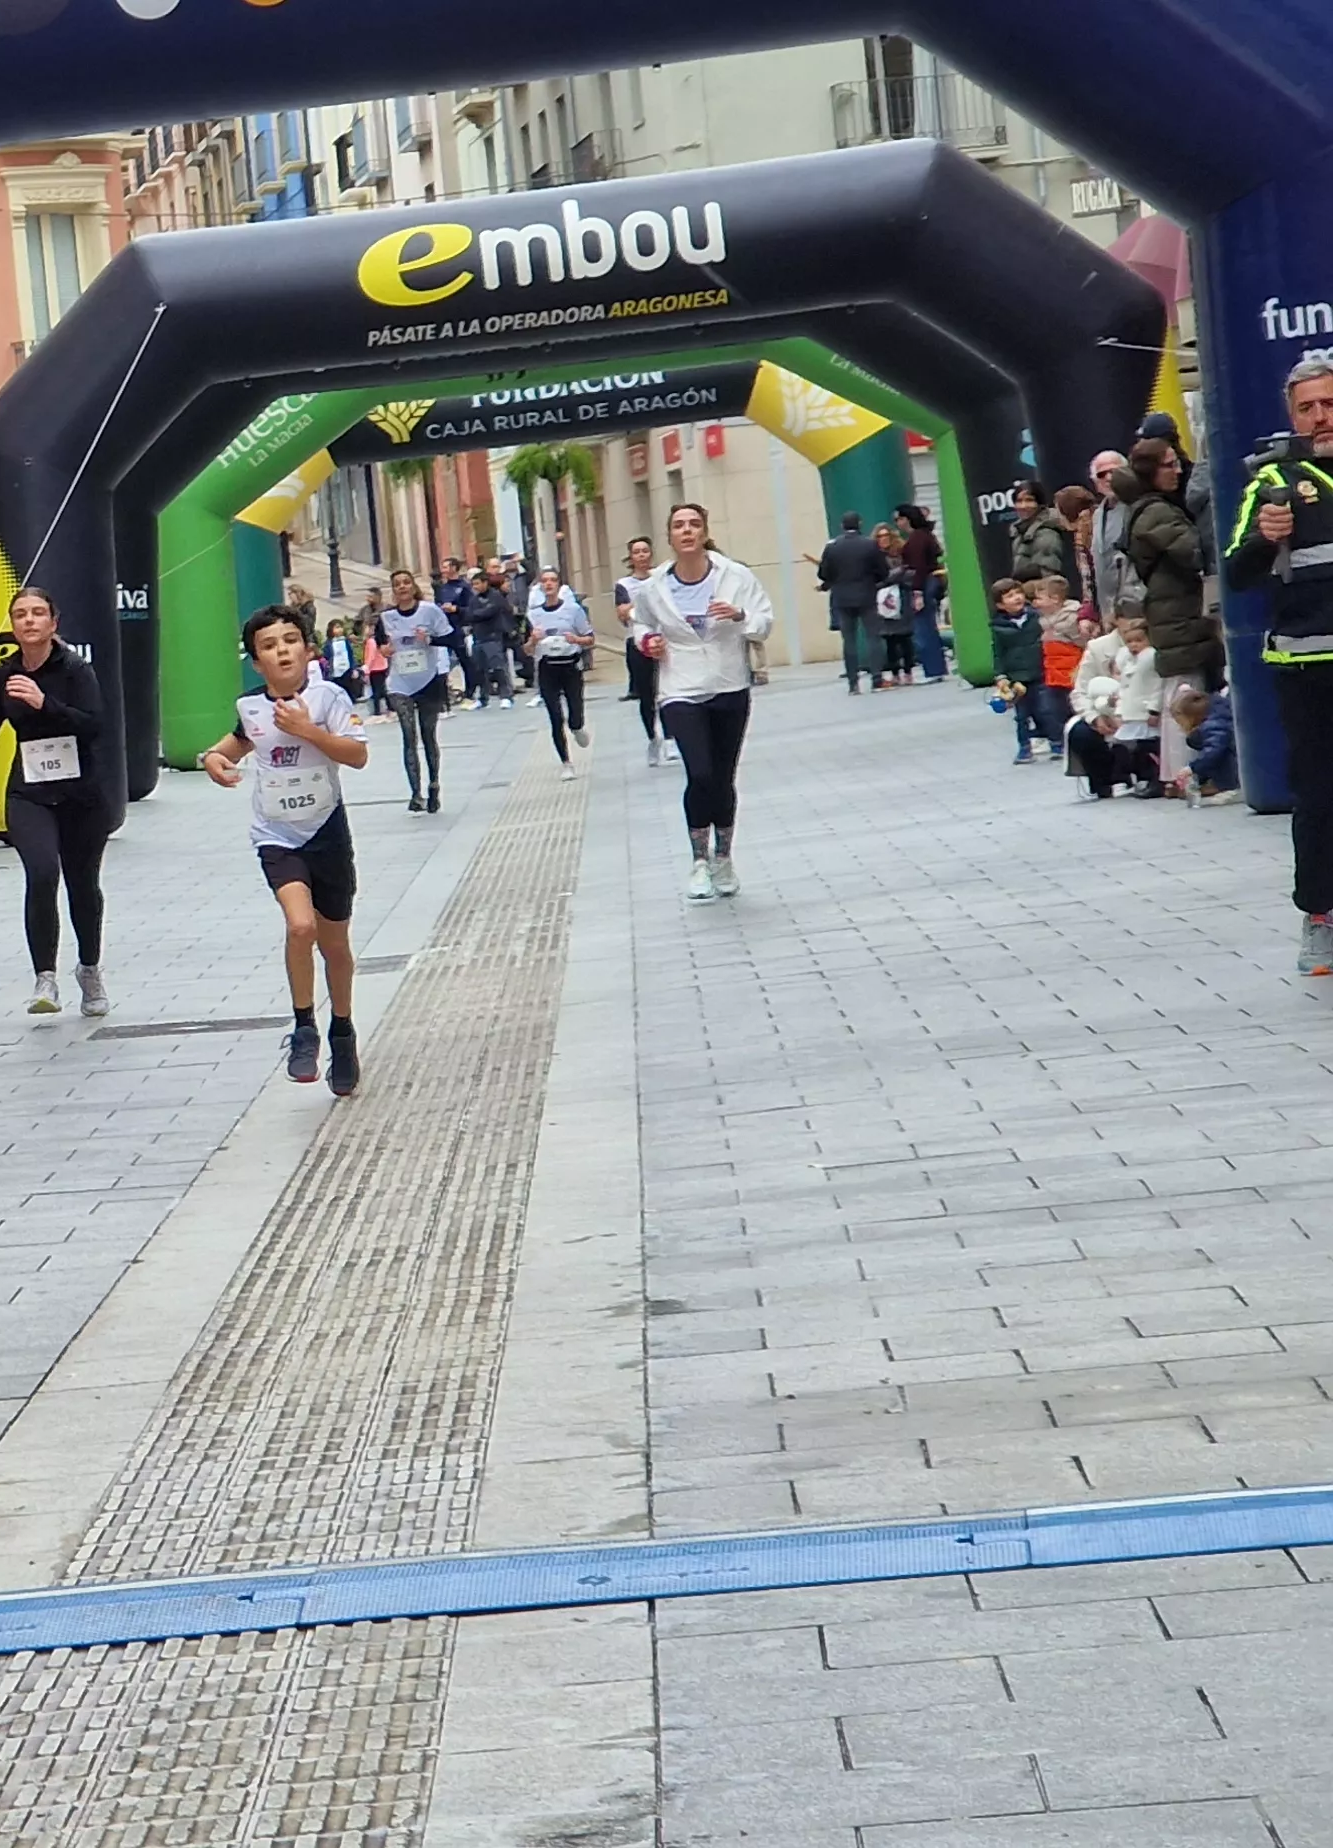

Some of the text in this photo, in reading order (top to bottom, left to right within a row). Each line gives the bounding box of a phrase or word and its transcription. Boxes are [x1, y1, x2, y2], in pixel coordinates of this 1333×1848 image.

[1070, 176, 1122, 214] RUGACA
[357, 198, 727, 307] embou
[367, 287, 730, 348] PÁSATE A LA OPERADORA ARAGONESA
[425, 386, 718, 441] CAJA RURAL DE ARAGÓN
[115, 582, 149, 610] iva
[39, 759, 62, 771] 105
[279, 793, 316, 810] 1025
